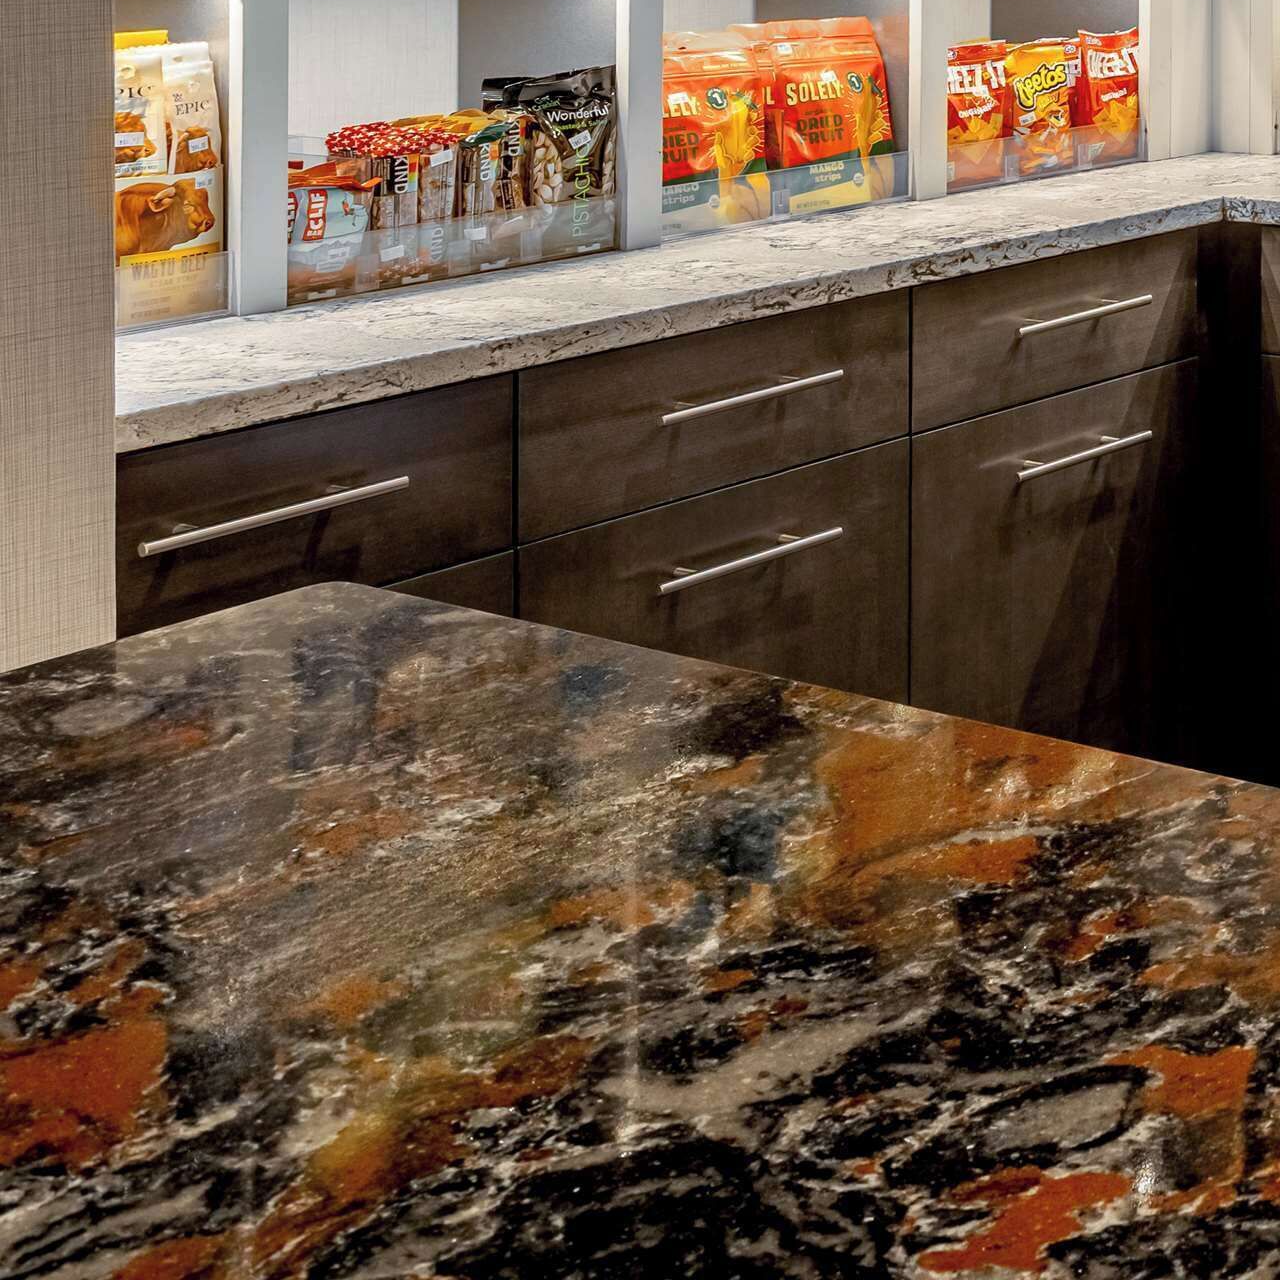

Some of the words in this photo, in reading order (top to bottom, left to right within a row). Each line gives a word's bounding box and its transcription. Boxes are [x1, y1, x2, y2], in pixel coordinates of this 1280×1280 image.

[176, 100, 210, 115] EPIC
[547, 106, 609, 122] Wonderful
[508, 120, 520, 156] KIND
[395, 157, 408, 194] KIND
[480, 143, 490, 181] KIND
[309, 192, 324, 230] CLIF
